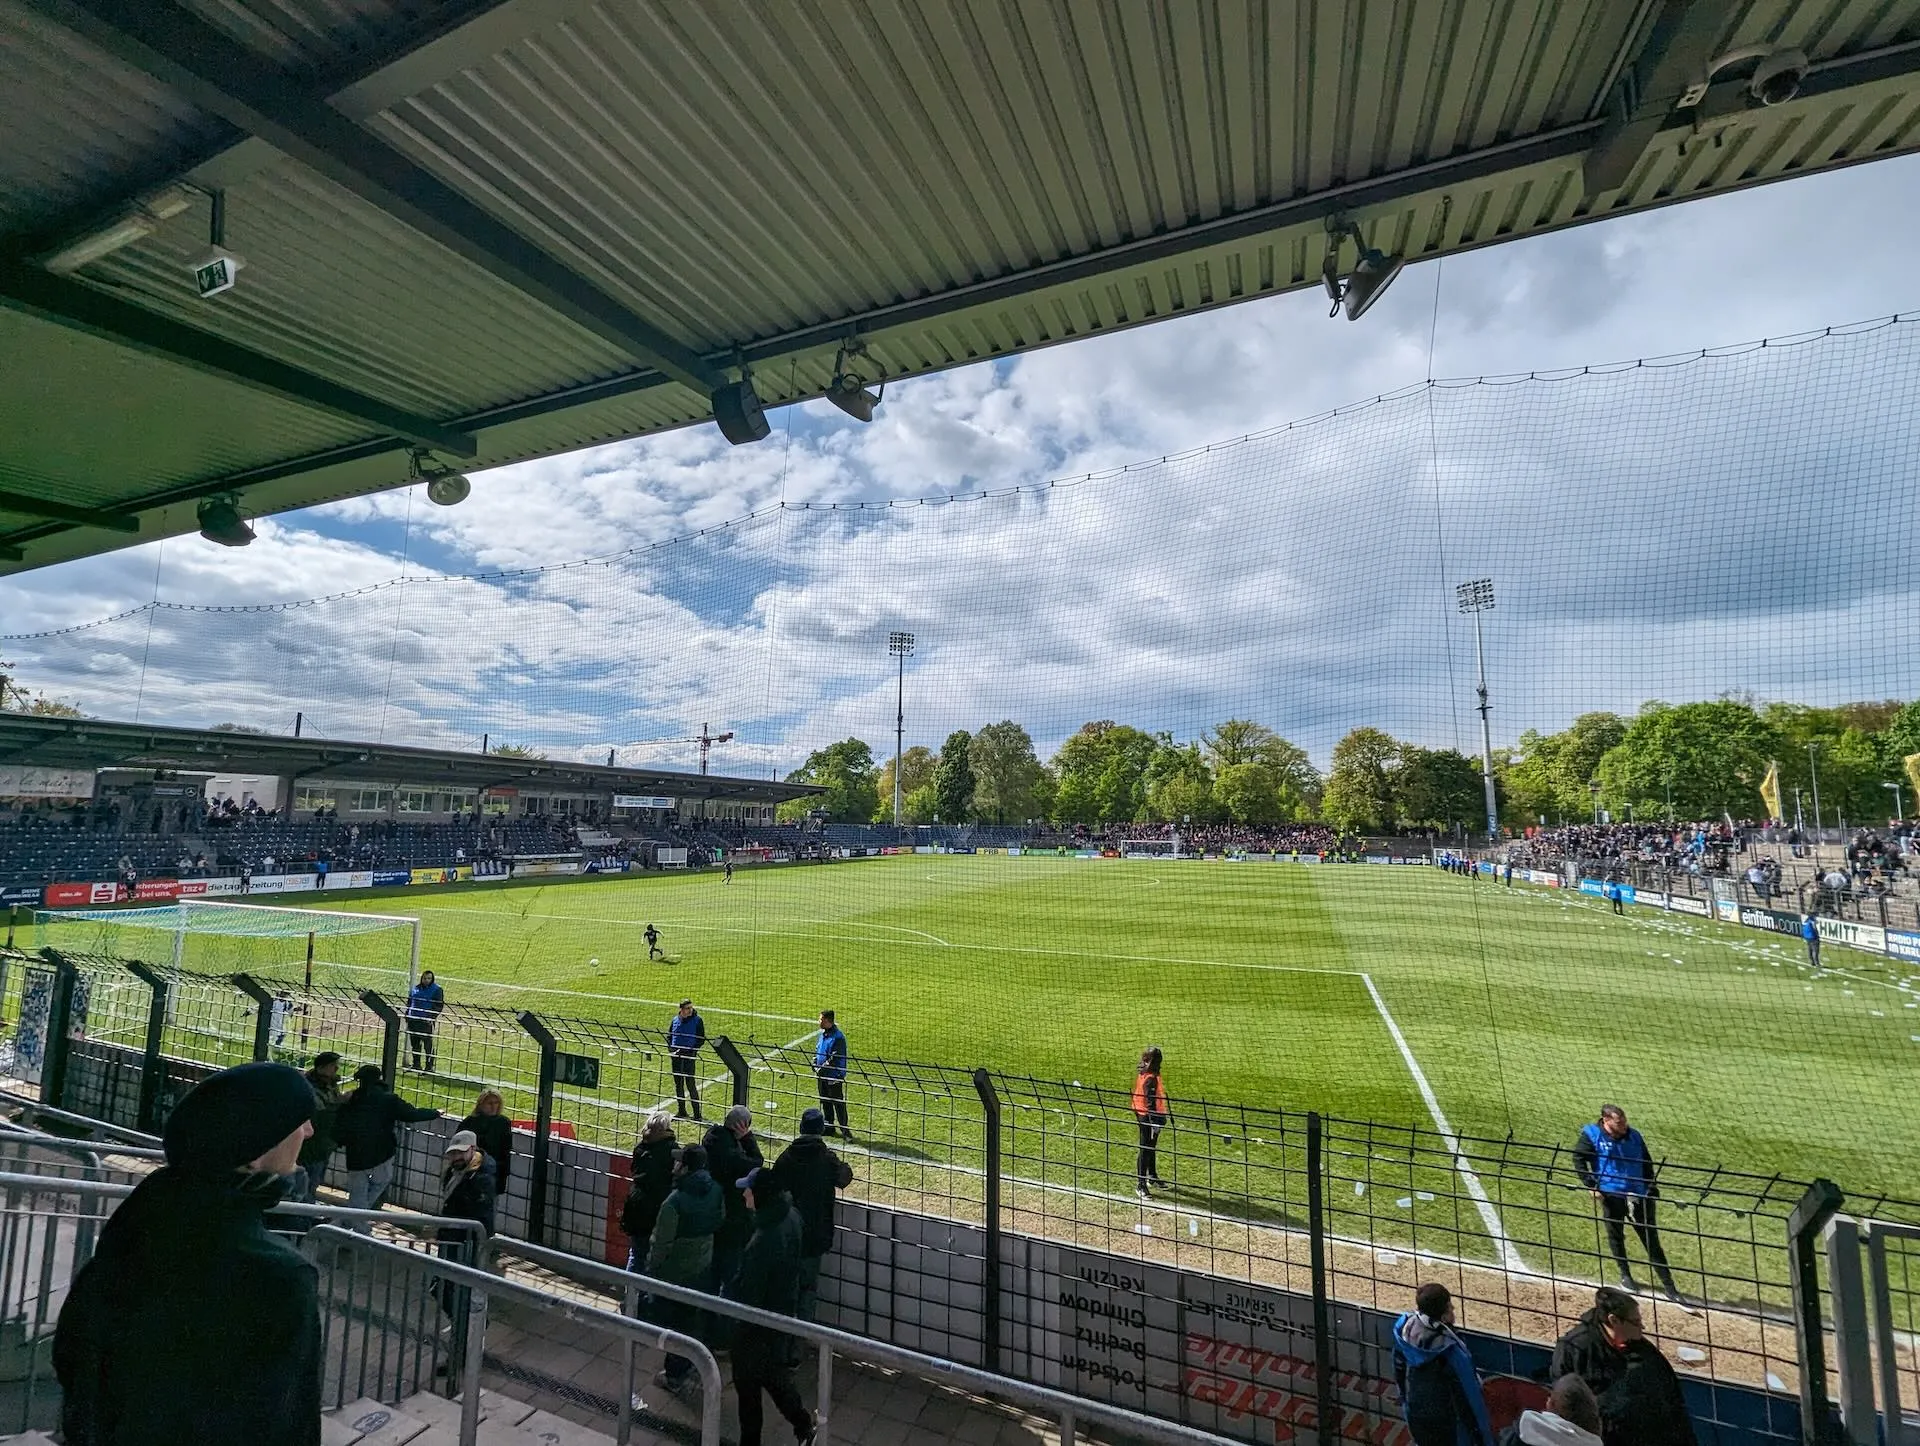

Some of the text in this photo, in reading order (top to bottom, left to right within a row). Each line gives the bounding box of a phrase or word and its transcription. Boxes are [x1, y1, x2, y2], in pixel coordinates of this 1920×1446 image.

[1742, 908, 1802, 935] einfilm.com
[1058, 1292, 1146, 1330] Glindow
[1226, 1293, 1276, 1315] SERVICE
[1075, 1326, 1146, 1362] Beelitz
